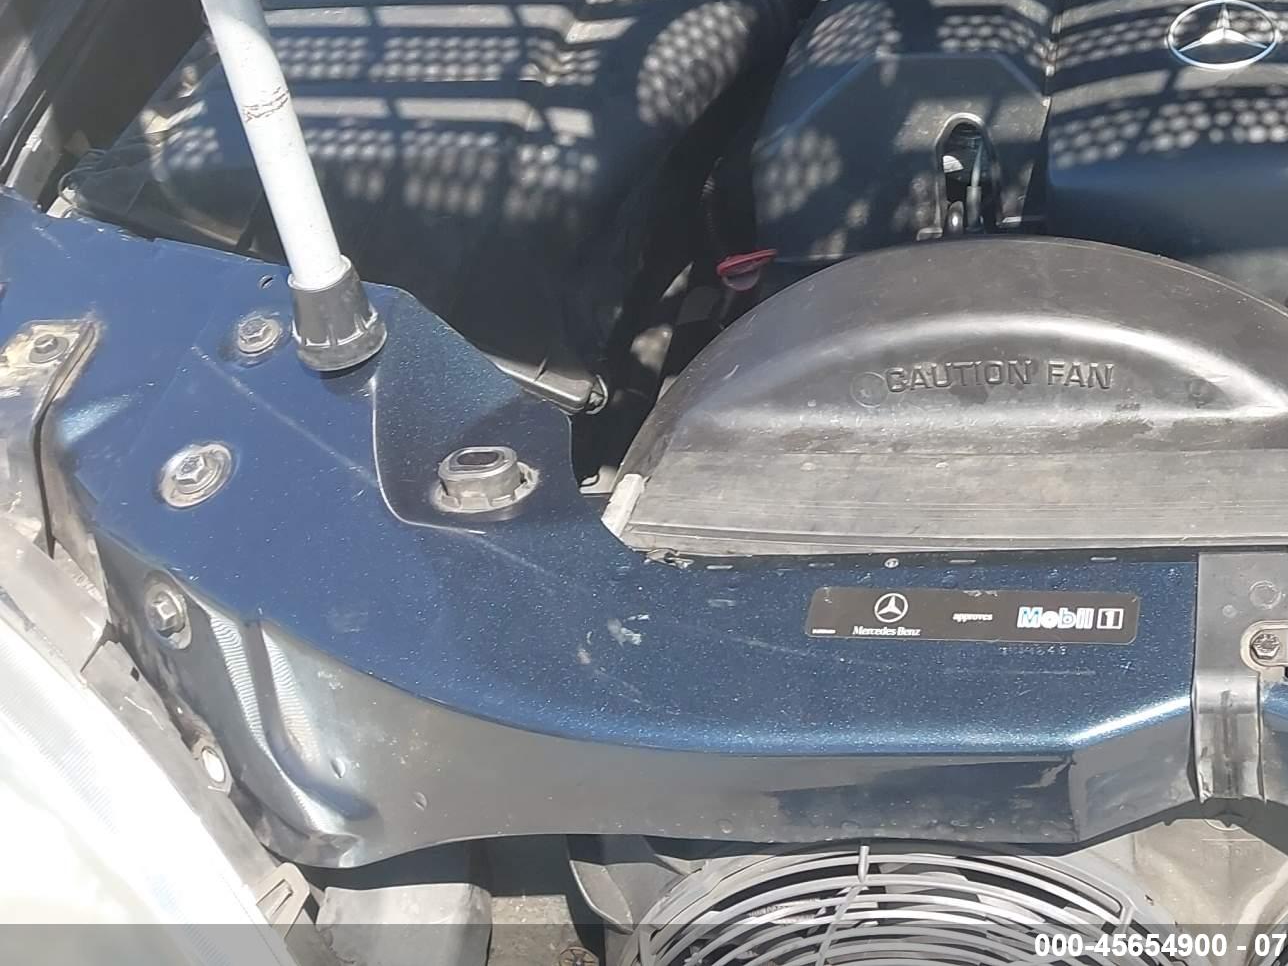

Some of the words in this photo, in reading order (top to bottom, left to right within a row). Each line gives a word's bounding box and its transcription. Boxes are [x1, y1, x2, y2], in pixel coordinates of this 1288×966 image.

[885, 359, 1032, 392] CAUTION
[1047, 360, 1114, 389] FAN
[1017, 607, 1094, 629] Mobil
